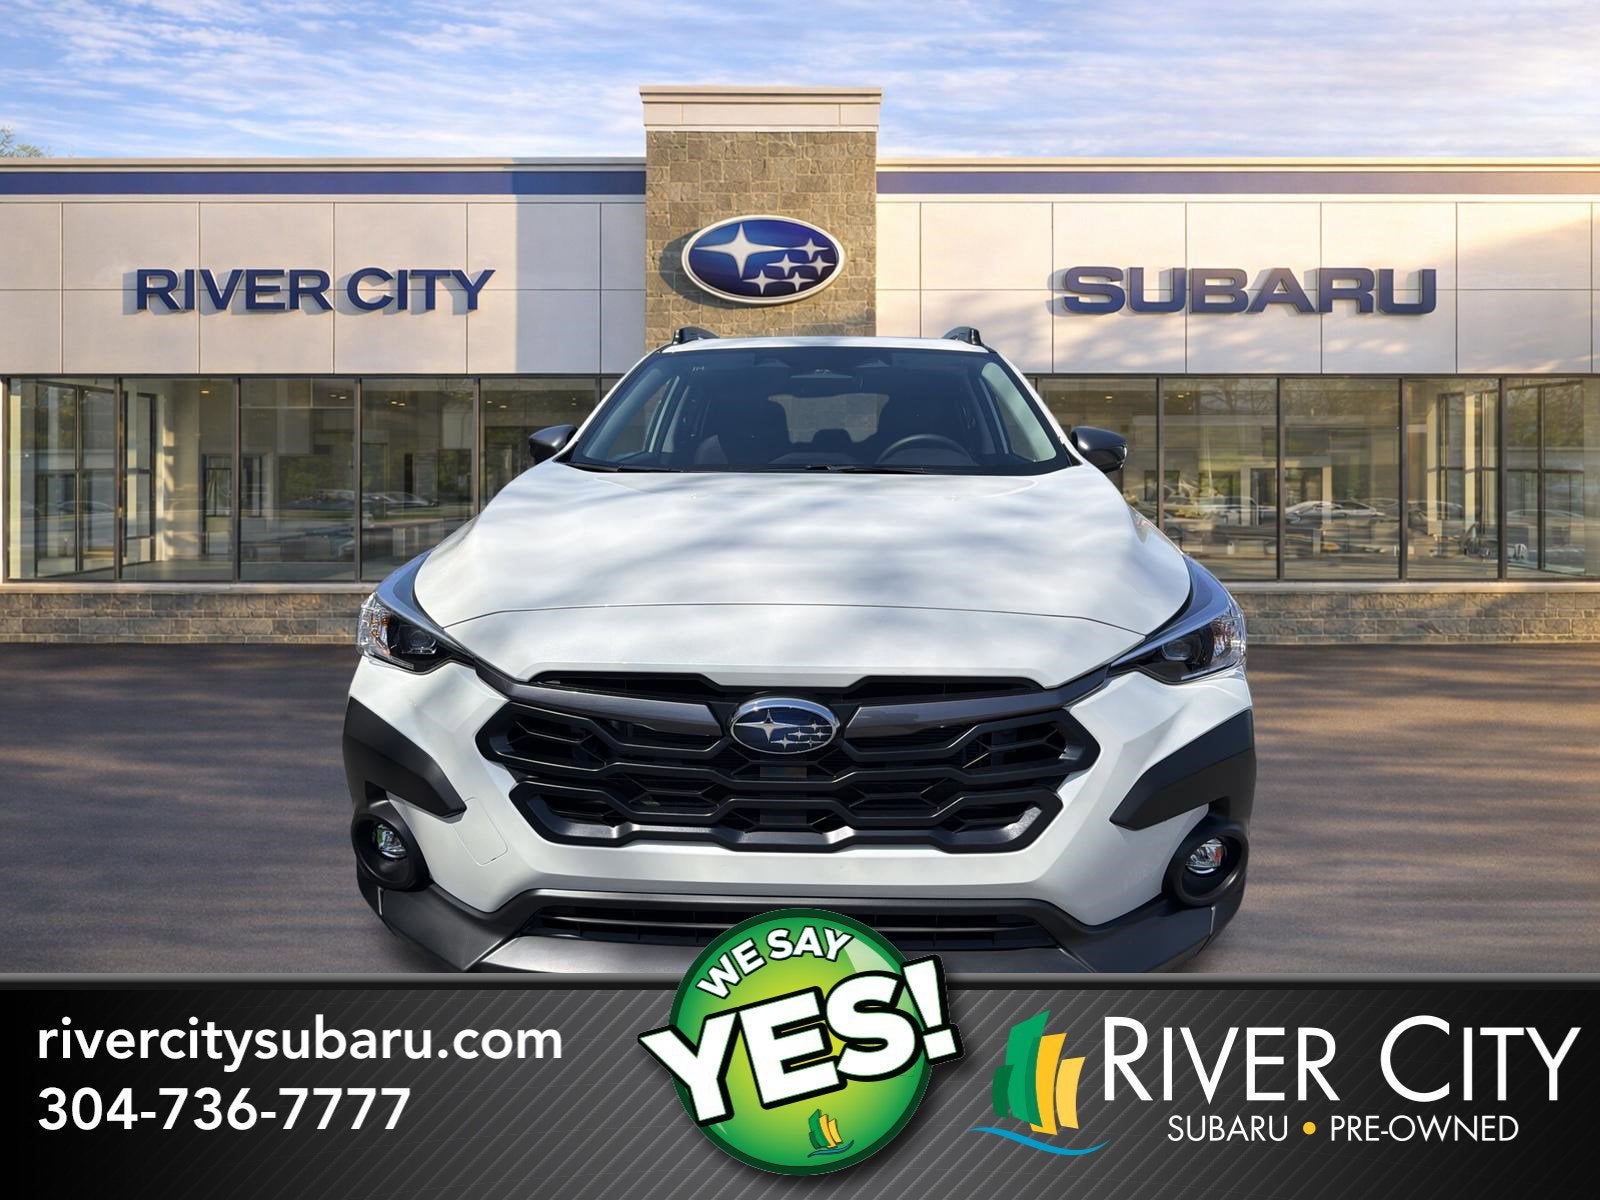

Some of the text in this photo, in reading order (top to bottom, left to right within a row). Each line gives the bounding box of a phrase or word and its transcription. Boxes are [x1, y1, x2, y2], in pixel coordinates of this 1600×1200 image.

[136, 267, 496, 312] RIVER CITY
[1062, 266, 1437, 315] SUBARU
